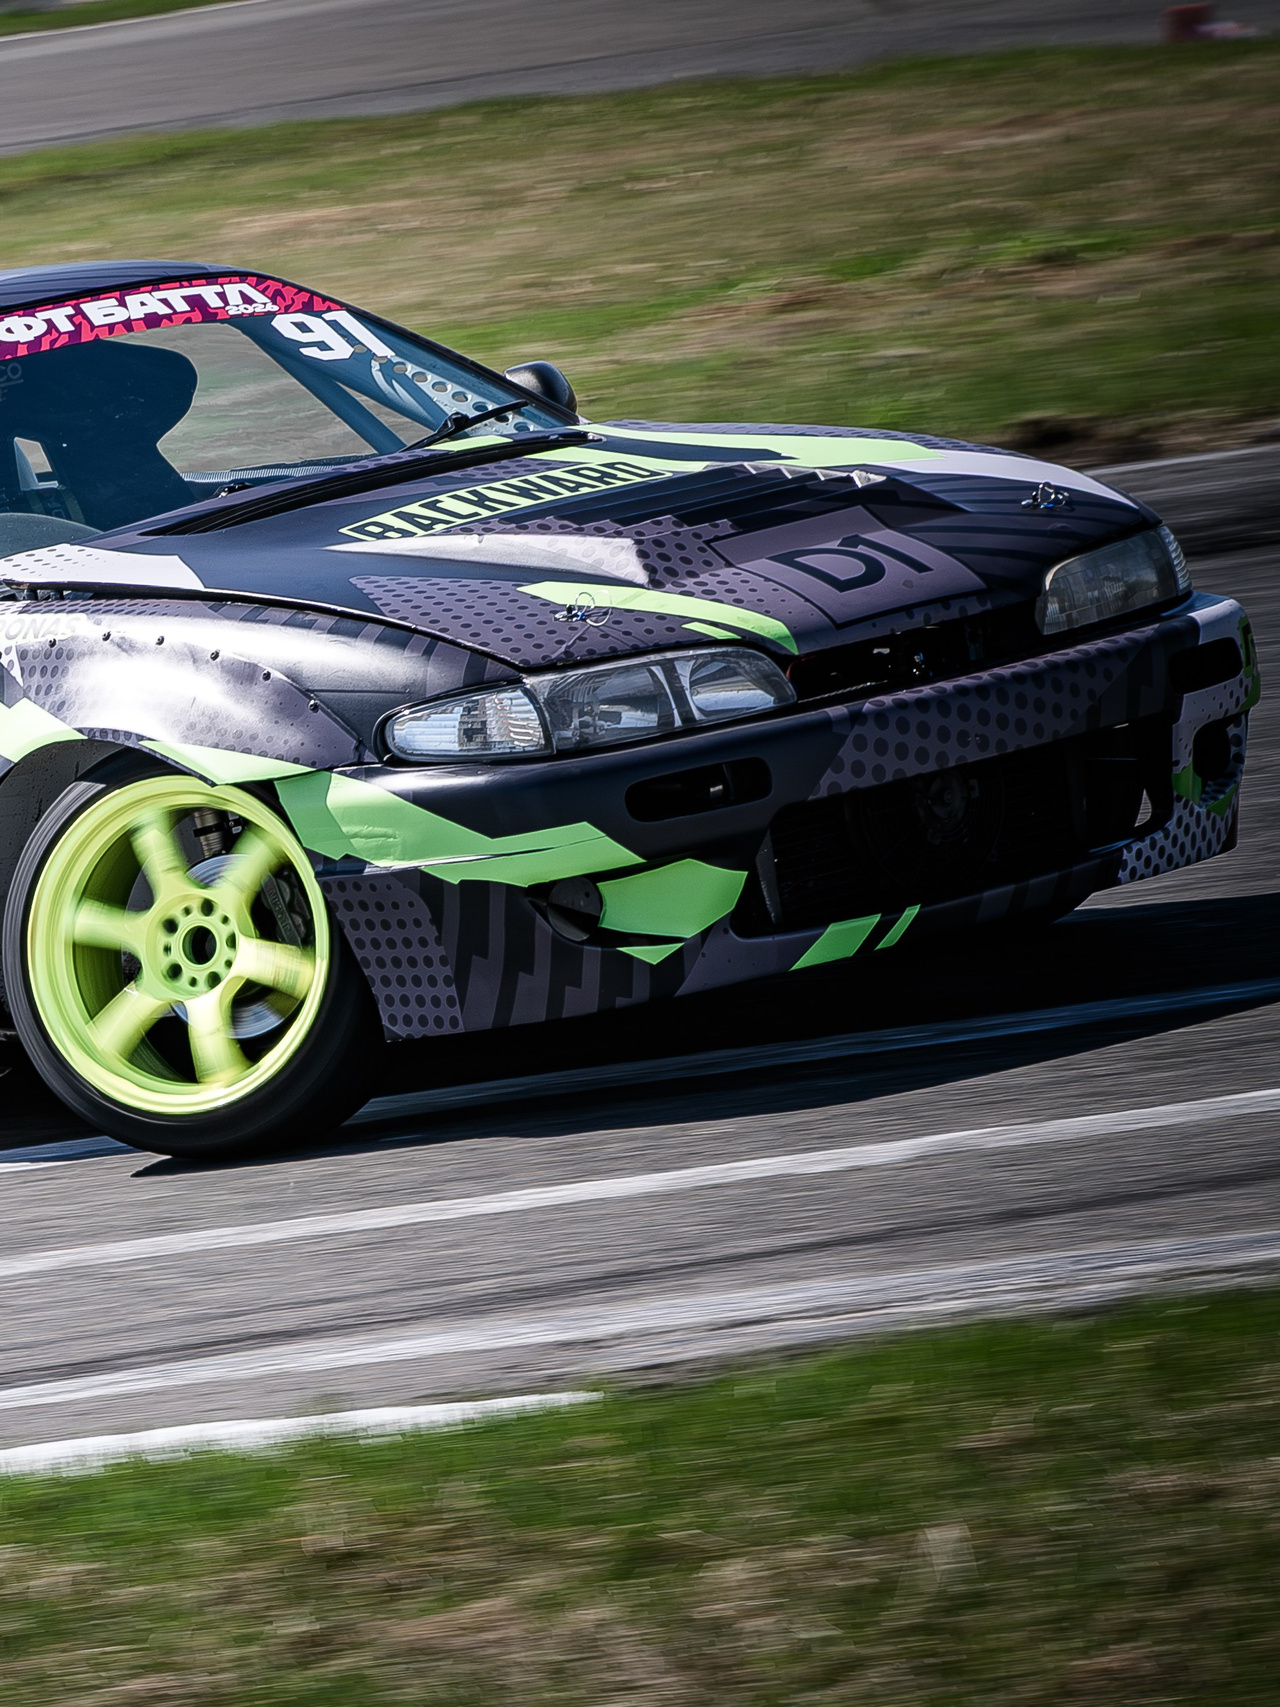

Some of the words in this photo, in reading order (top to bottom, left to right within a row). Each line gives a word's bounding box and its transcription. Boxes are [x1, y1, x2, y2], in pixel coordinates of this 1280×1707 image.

[81, 283, 272, 327] БАТТЛ
[224, 301, 280, 316] 2026
[271, 309, 396, 361] 91
[345, 461, 664, 541] BACKWARD
[765, 533, 935, 593] D1
